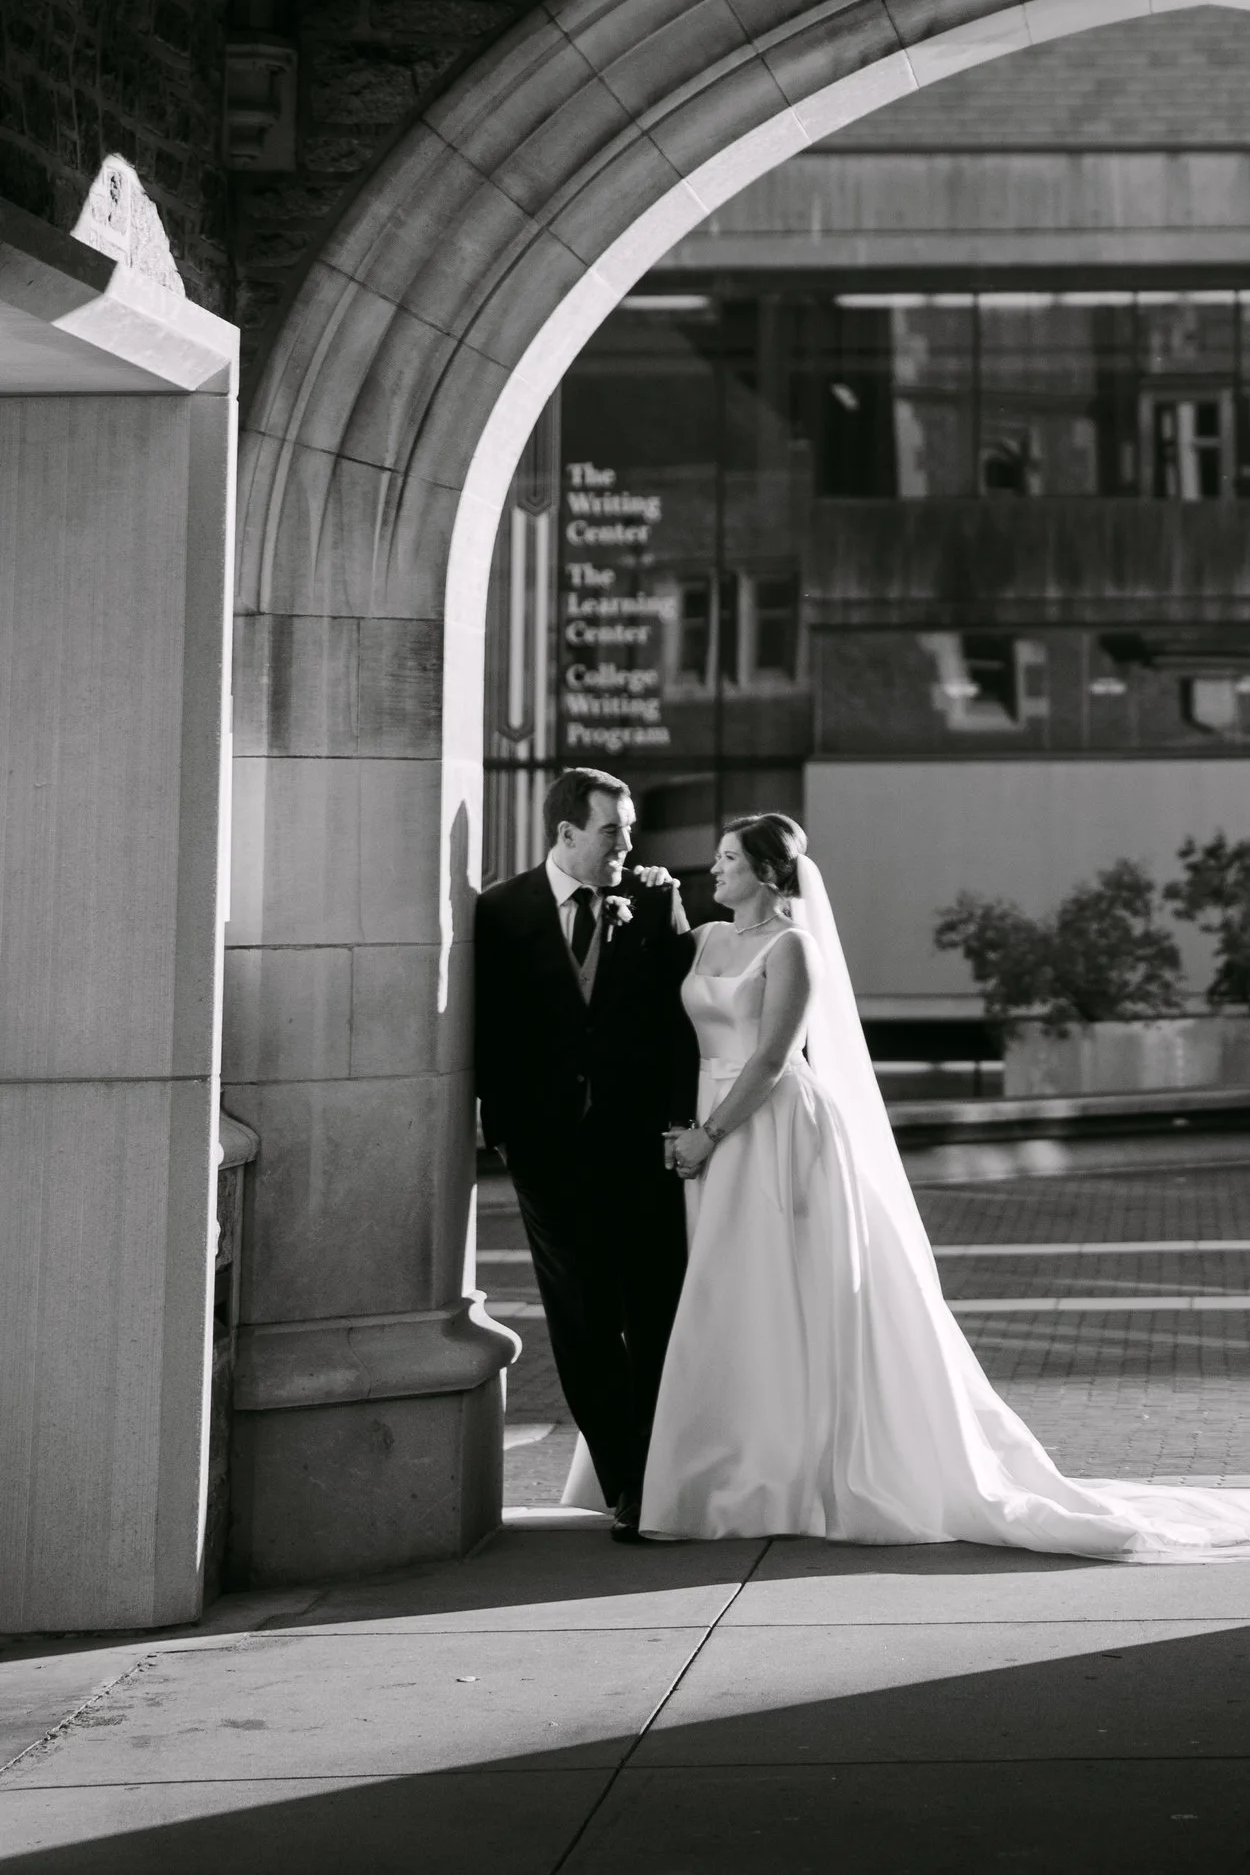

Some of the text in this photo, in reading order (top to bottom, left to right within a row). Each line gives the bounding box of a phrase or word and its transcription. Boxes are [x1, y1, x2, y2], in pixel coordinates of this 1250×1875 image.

[566, 463, 616, 488] The
[567, 493, 661, 522] Writing
[566, 521, 651, 546] Center
[566, 563, 616, 588] The
[567, 592, 677, 622] Learning
[566, 621, 651, 646] Center
[566, 663, 658, 694] College
[566, 693, 661, 722] Writing
[566, 724, 670, 754] Program
